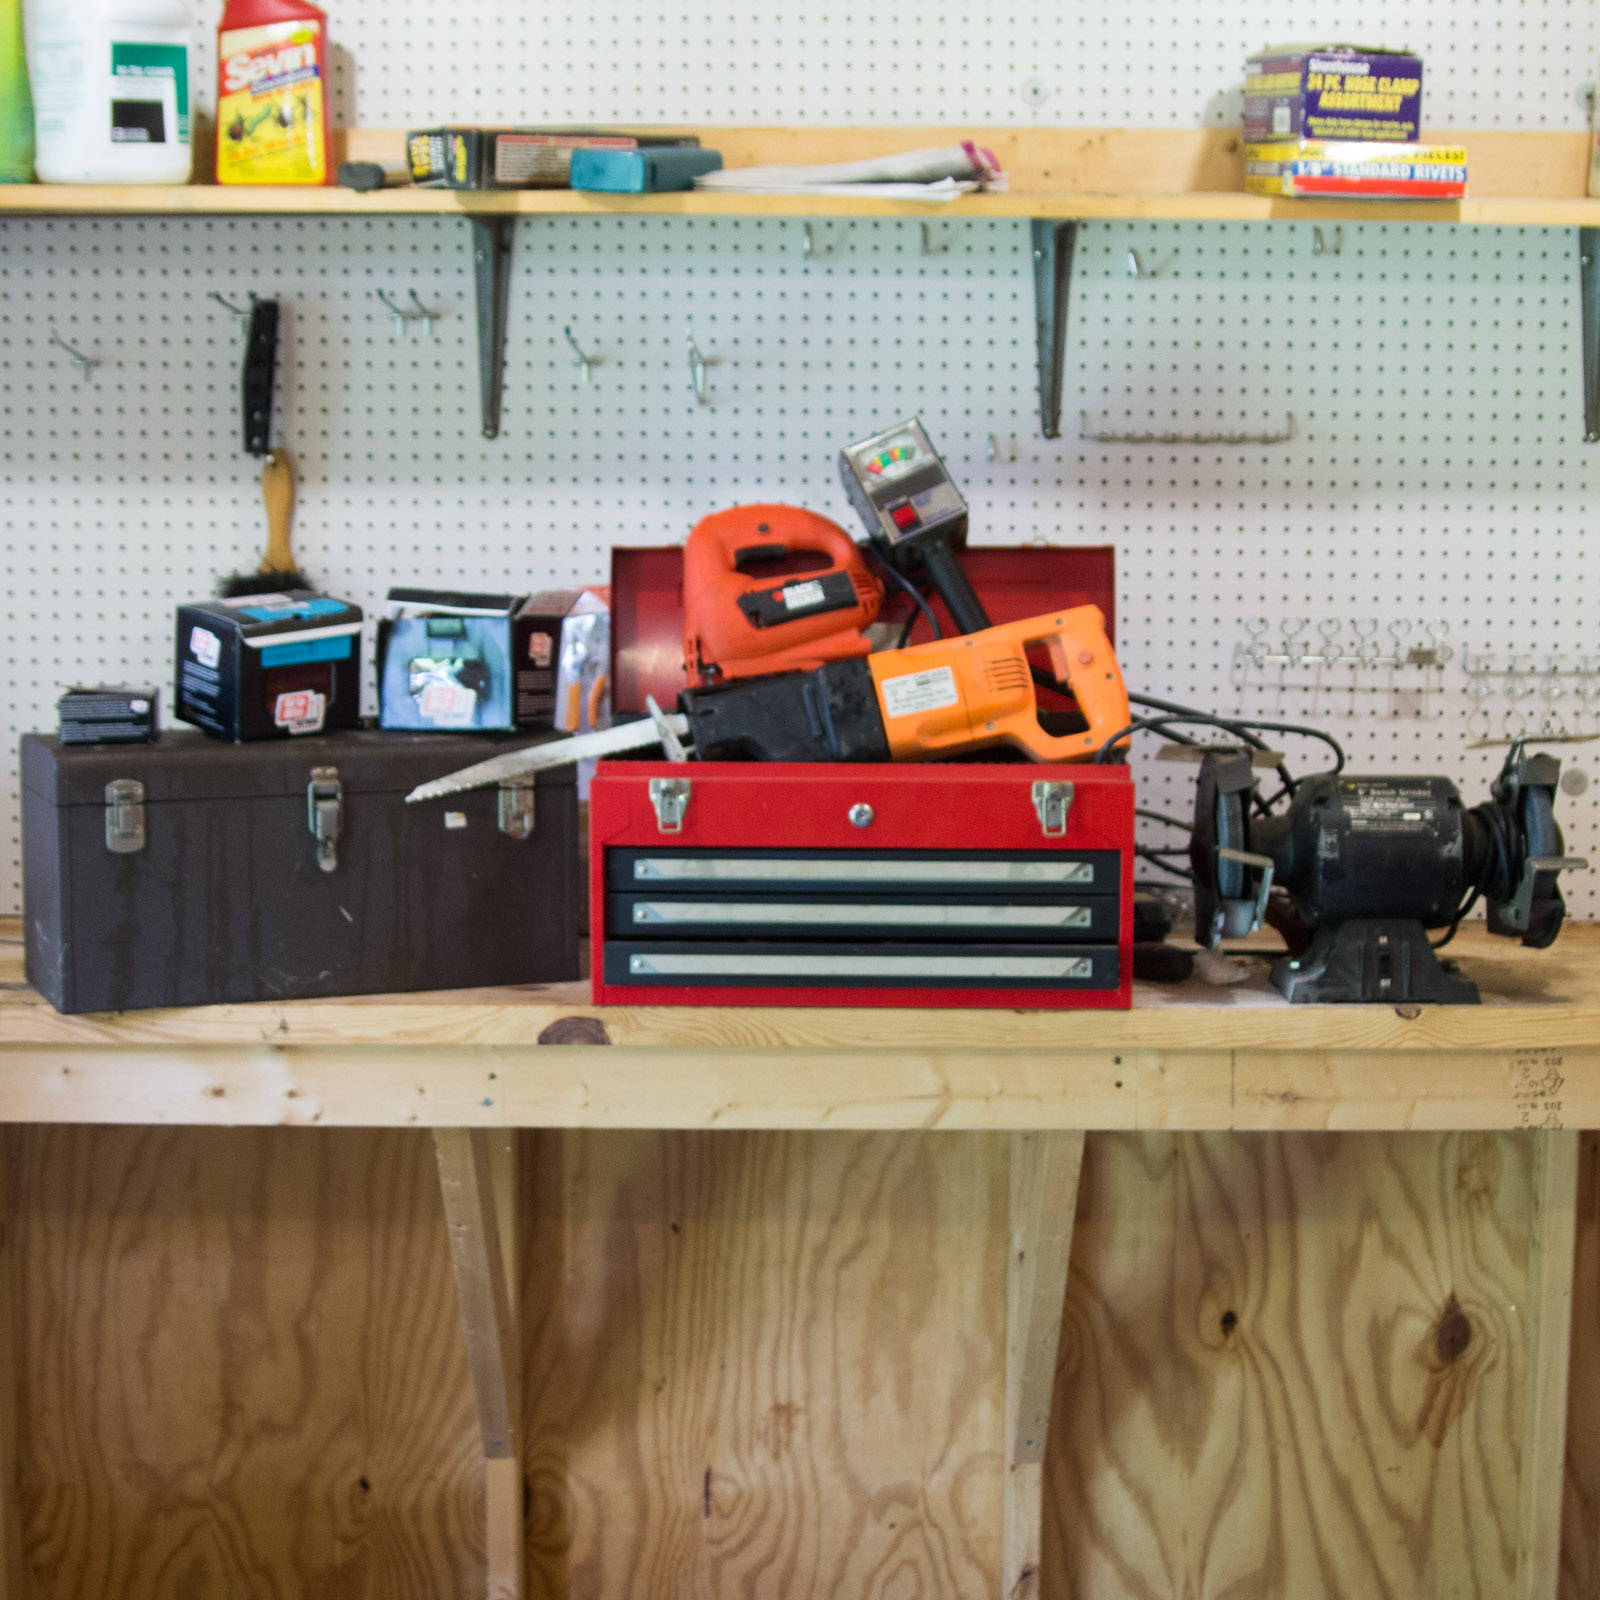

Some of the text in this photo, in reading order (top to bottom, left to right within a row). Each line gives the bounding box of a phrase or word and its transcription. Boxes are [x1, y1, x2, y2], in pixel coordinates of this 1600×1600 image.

[224, 43, 316, 90] Sevin
[1309, 58, 1370, 75] Storehouse
[1344, 75, 1377, 92] HOSE
[1377, 76, 1420, 96] CLAMP
[1318, 91, 1403, 112] ASSORTMENT
[1332, 161, 1411, 179] STANDARD
[1413, 164, 1465, 182] RIVETS
[1370, 788, 1397, 796] Bench
[1399, 788, 1431, 797] Grinder
[1521, 1111, 1530, 1123] 2
